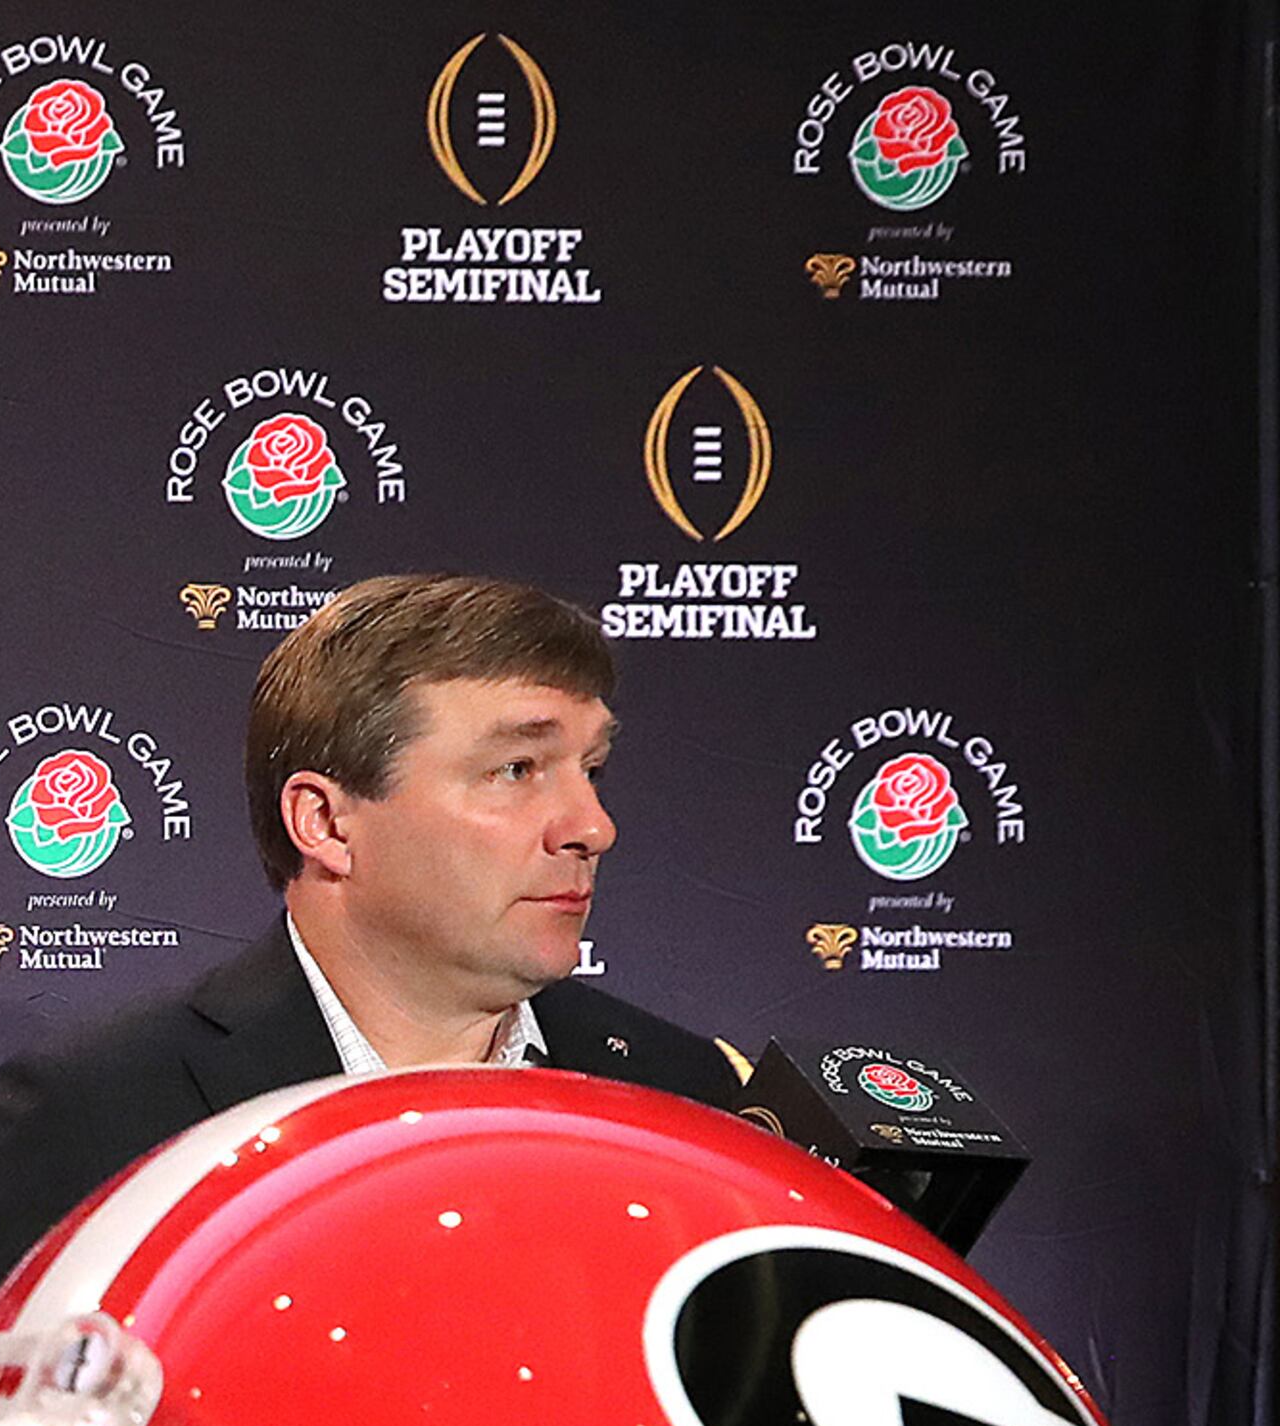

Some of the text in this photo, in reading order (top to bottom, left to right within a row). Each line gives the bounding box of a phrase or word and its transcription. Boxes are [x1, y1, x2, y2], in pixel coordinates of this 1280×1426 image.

[1, 35, 114, 75] BOWL
[121, 63, 184, 168] GAME
[794, 42, 1025, 174] ROSE BOWL GAME
[20, 216, 111, 237] presented by
[868, 222, 953, 242] presented by
[401, 228, 582, 262] PLAYOFF
[14, 249, 171, 271] Northwestern
[860, 255, 1011, 277] Northwestern
[14, 271, 98, 293] Mutual
[383, 267, 601, 302] SEMIFINAL
[860, 278, 939, 299] Mutual
[167, 368, 405, 503] ROSE BOWL GAME
[244, 552, 332, 573] presented by
[619, 564, 798, 598] PLAYOFF
[237, 586, 341, 607] Northwe
[237, 609, 316, 629] Mutua
[601, 603, 816, 639] SEMIFINAL
[8, 704, 120, 745] BOWL
[128, 733, 190, 840] GAME
[795, 707, 1024, 844] ROSE BOWL GAME
[27, 890, 117, 911] presented by
[869, 892, 955, 913] presented by
[20, 924, 178, 945] Northwestern
[860, 925, 1011, 947] Northwestern
[20, 947, 104, 969] Mutual
[861, 948, 940, 970] Mutual
[820, 1047, 974, 1103] ROSE BOWL GAME
